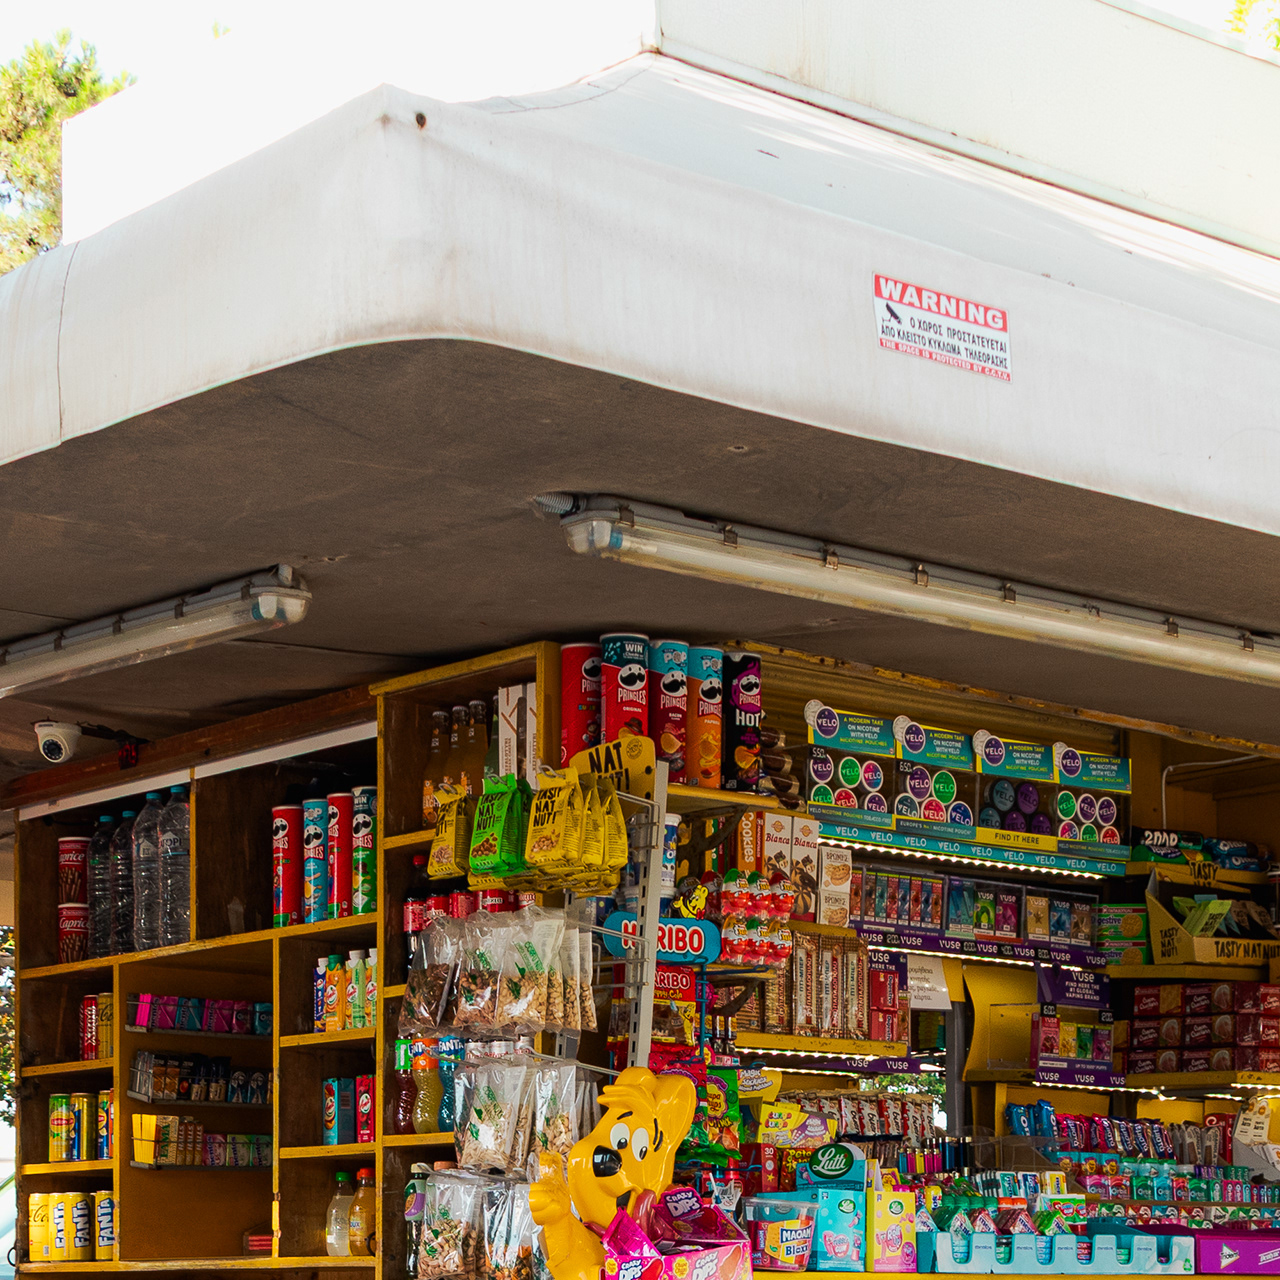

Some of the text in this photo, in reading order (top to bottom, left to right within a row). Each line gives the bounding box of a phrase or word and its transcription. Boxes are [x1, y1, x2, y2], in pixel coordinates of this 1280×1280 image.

[878, 276, 1004, 330] WARNING
[917, 317, 943, 336] ΧΩΡΟΣ
[946, 328, 1007, 354] ΠΡΟΣΤΑΤΕΥΕΤΑΙ
[881, 323, 1008, 370] ΑΠΟ ΚΛΕΙΣΤΟ ΚΥΚΛΩΜΑ ΤΗΛΕΟΡΑΣΗΣ
[881, 338, 896, 351] THE
[898, 342, 920, 357] SPACE
[922, 348, 930, 359] IS
[932, 350, 971, 371] PROTECTED
[973, 362, 983, 375] BY
[624, 642, 643, 654] WIN
[617, 687, 647, 705] PRINGLES
[735, 708, 761, 727] HOT
[816, 718, 838, 727] VELO
[905, 734, 925, 743] VELO
[587, 741, 623, 775] NAT
[984, 746, 1003, 756] VELO
[812, 762, 832, 772] VELO
[478, 805, 495, 817] NAT
[535, 799, 556, 815] NAT
[476, 814, 496, 832] NUT!
[533, 811, 556, 828] NUT!
[741, 811, 755, 863] Cookies
[870, 831, 893, 843] VELO
[994, 832, 1040, 845] FIND IT HERE
[938, 841, 961, 852] VELO
[1003, 851, 1025, 862] VELO
[1065, 859, 1087, 869] VELO
[1190, 860, 1219, 880] TASTY
[621, 919, 706, 955] HRIBO
[654, 970, 691, 990] ARIBO
[764, 1147, 774, 1155] 30
[811, 1147, 849, 1175] Lutti
[665, 1198, 701, 1218] DIPS
[54, 1201, 66, 1249] FANTA
[73, 1200, 91, 1248] FANTA
[780, 1225, 812, 1243] MAOAM
[621, 1258, 642, 1271] CRAZY
[694, 1252, 718, 1268] CRAZY
